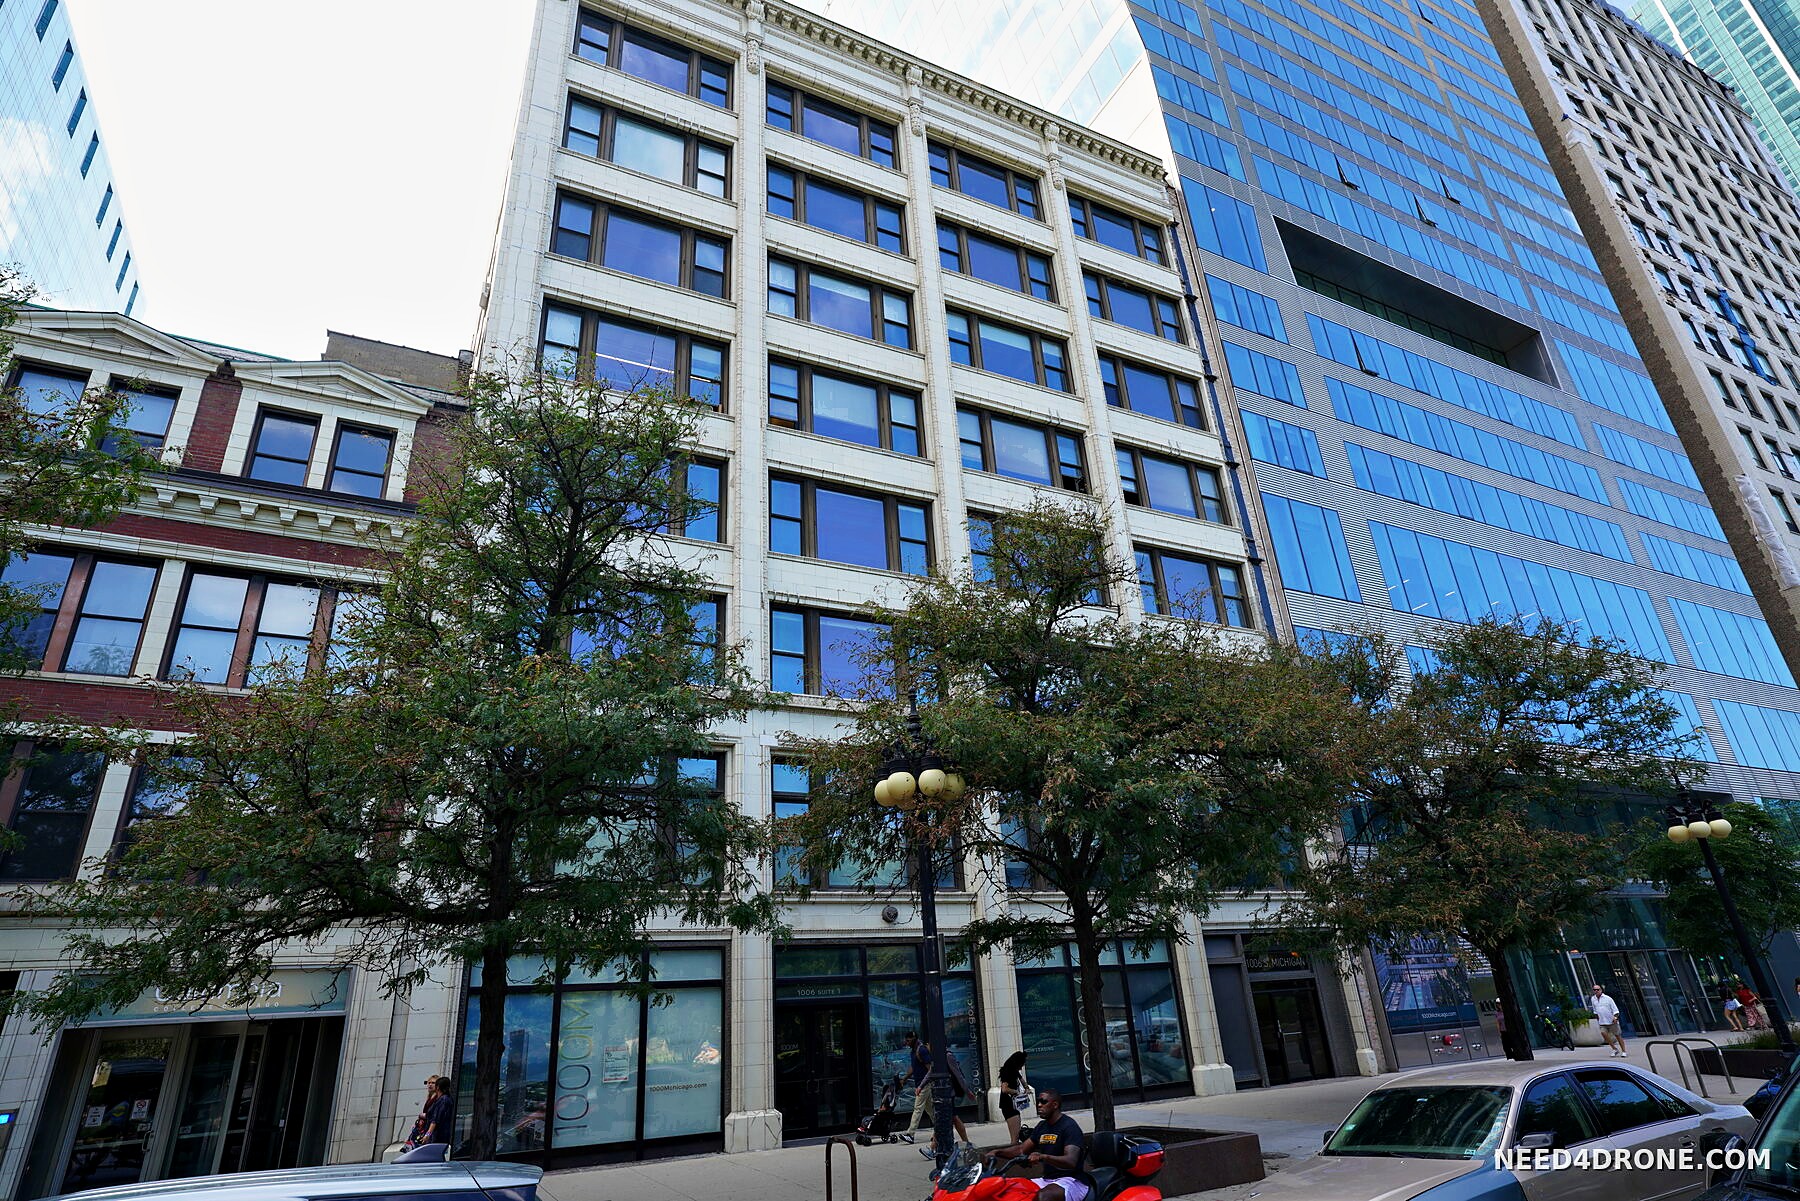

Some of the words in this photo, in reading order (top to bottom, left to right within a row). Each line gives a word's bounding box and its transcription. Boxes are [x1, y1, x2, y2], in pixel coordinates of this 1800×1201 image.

[1272, 956, 1306, 967] MICHIGAN
[155, 981, 282, 1002] Cumbia
[554, 999, 593, 1137] 1000M
